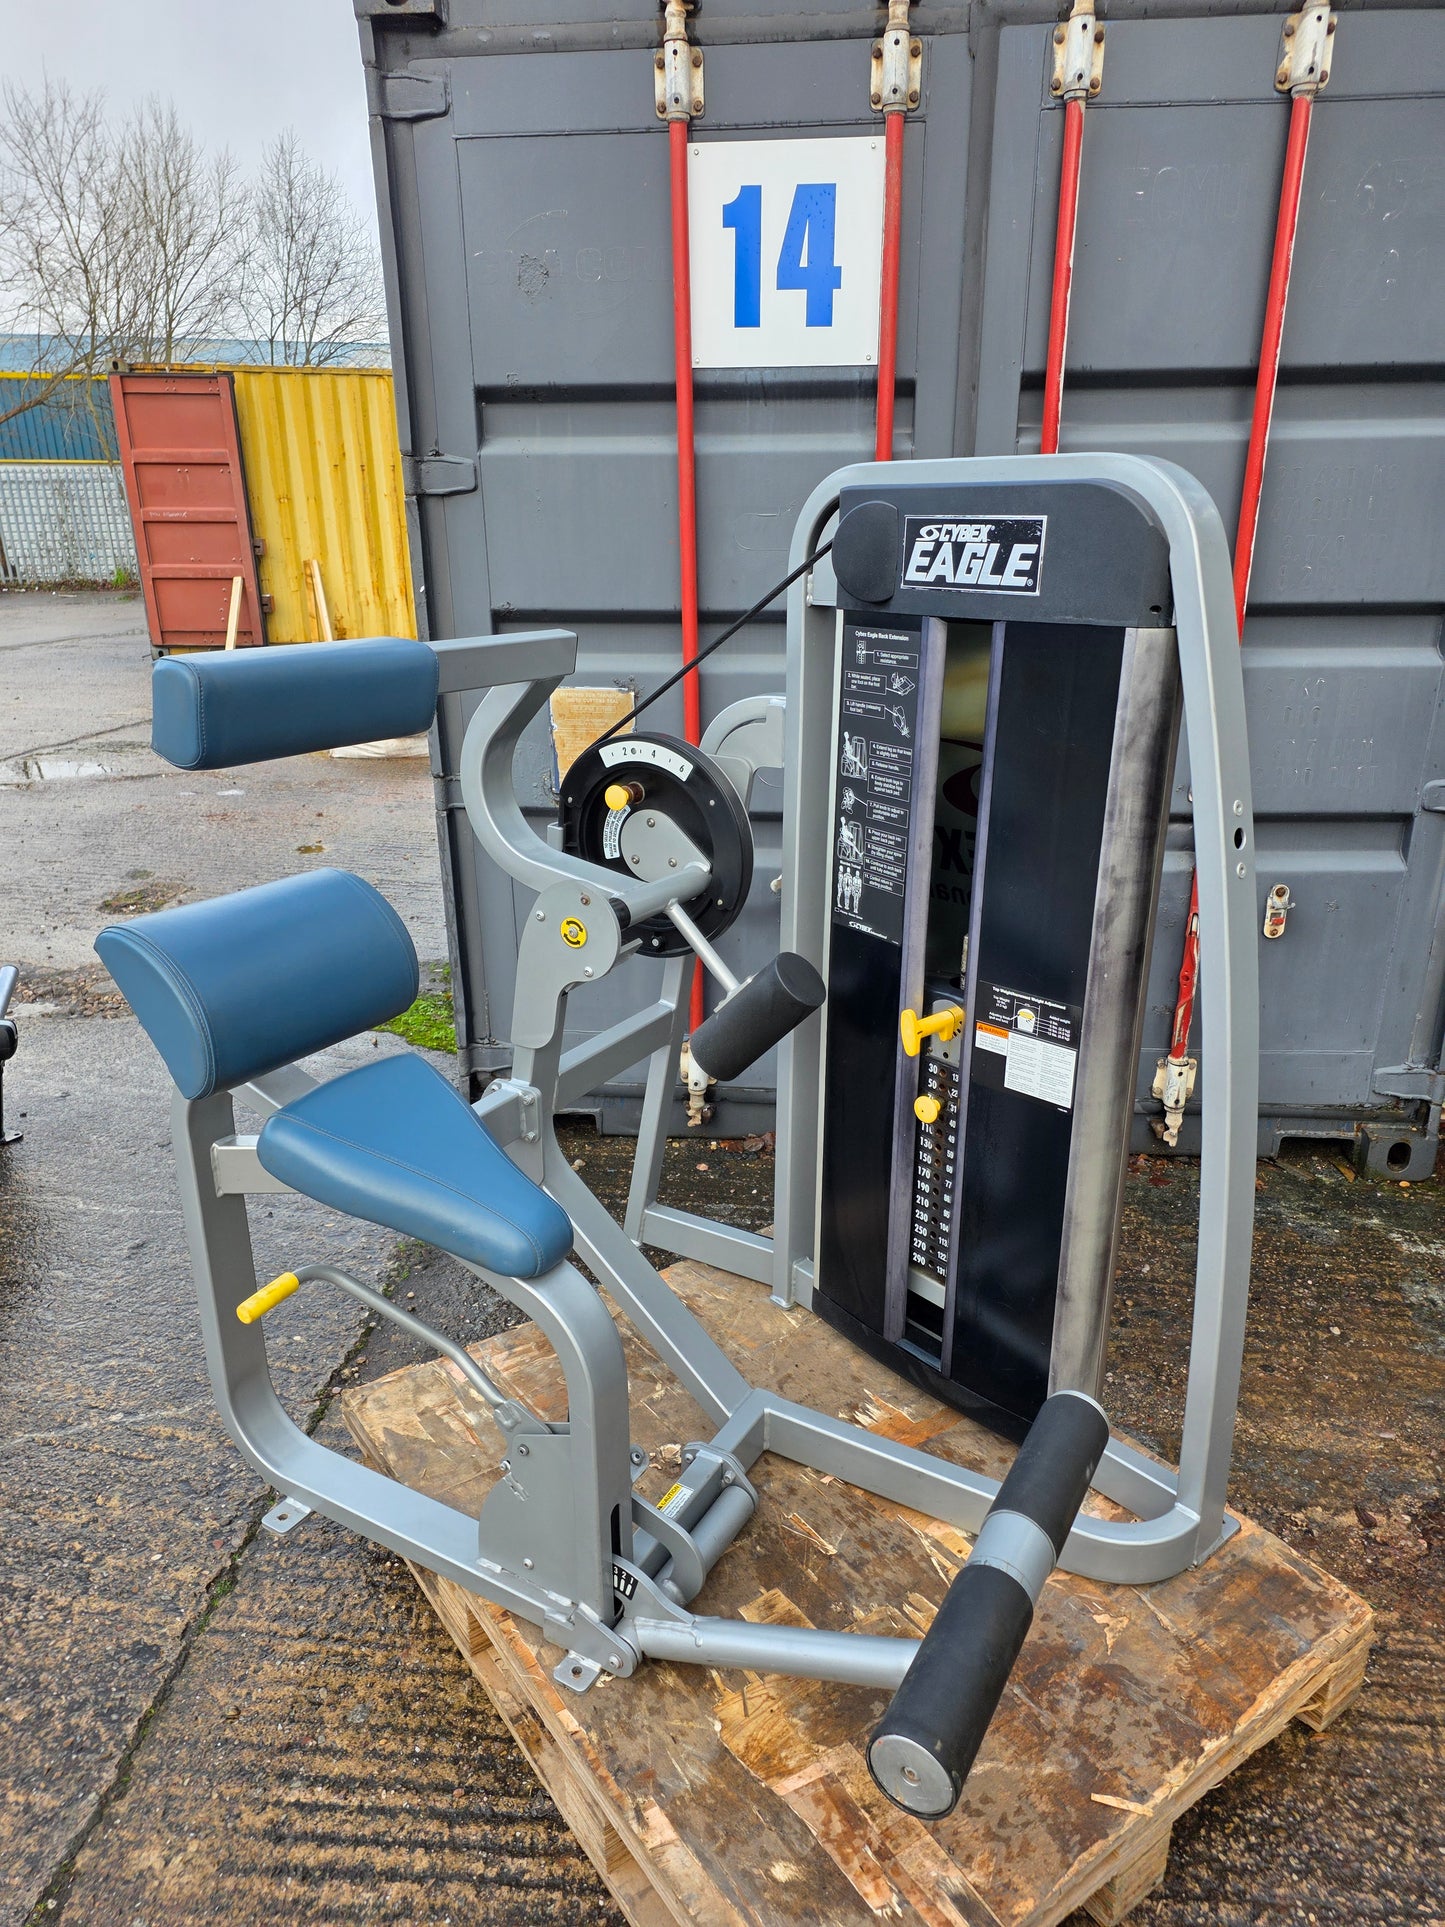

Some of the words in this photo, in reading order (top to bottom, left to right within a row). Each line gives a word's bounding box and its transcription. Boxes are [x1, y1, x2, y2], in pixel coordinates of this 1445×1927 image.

[722, 182, 842, 328] 14
[938, 524, 992, 542] CYBEX
[904, 542, 1038, 586] EAGLE
[622, 747, 627, 755] 2
[652, 750, 656, 758] 4
[680, 764, 685, 772] 6
[928, 1063, 938, 1074] 30
[928, 1078, 937, 1090] 50
[952, 1073, 958, 1082] 13
[951, 1089, 958, 1098] 22
[950, 1104, 957, 1113] 31
[920, 1136, 932, 1150] 130
[920, 1151, 932, 1164] 150
[918, 1166, 930, 1179] 170
[917, 1180, 930, 1194] 190
[945, 1180, 952, 1188] 77
[916, 1194, 929, 1208] 210
[916, 1209, 928, 1222] 230
[914, 1224, 928, 1236] 250
[913, 1238, 926, 1251] 270
[913, 1252, 926, 1266] 290
[660, 1484, 680, 1506] CAUTION
